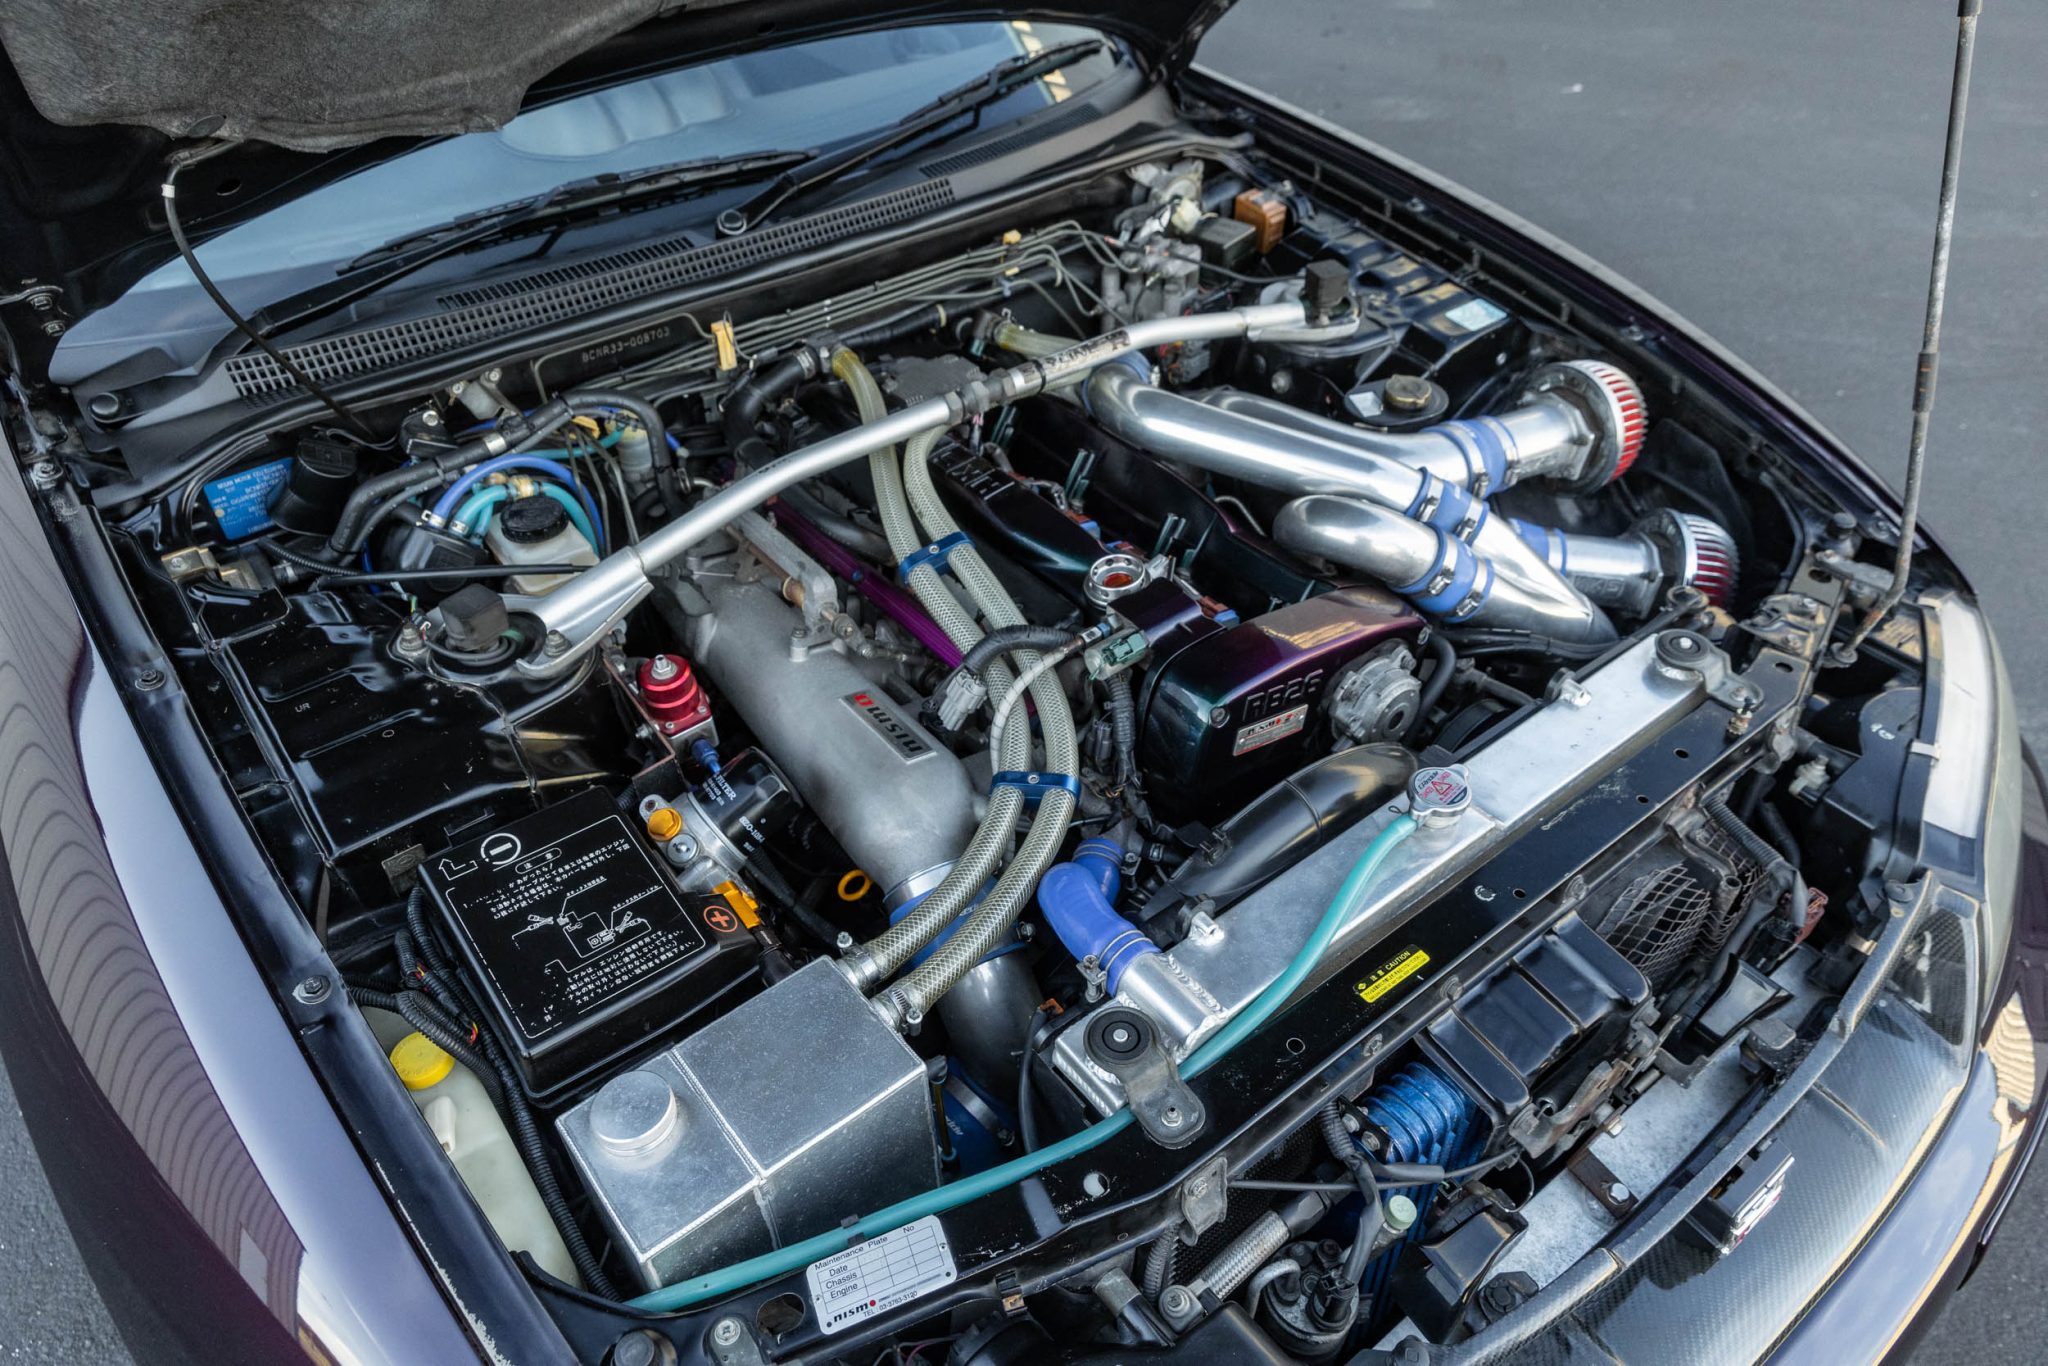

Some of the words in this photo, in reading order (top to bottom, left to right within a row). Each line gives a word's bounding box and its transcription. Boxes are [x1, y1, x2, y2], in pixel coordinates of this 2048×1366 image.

[1242, 668, 1323, 722] RB26
[852, 692, 924, 753] nismo
[1385, 950, 1411, 970] CAUTION
[814, 1246, 864, 1270] Maintenance
[867, 1235, 888, 1249] Plate
[903, 1225, 915, 1234] No
[825, 1272, 858, 1290] Chassis
[829, 1265, 848, 1277] Date
[830, 1282, 858, 1299] Engine
[833, 1299, 877, 1323] nismo
